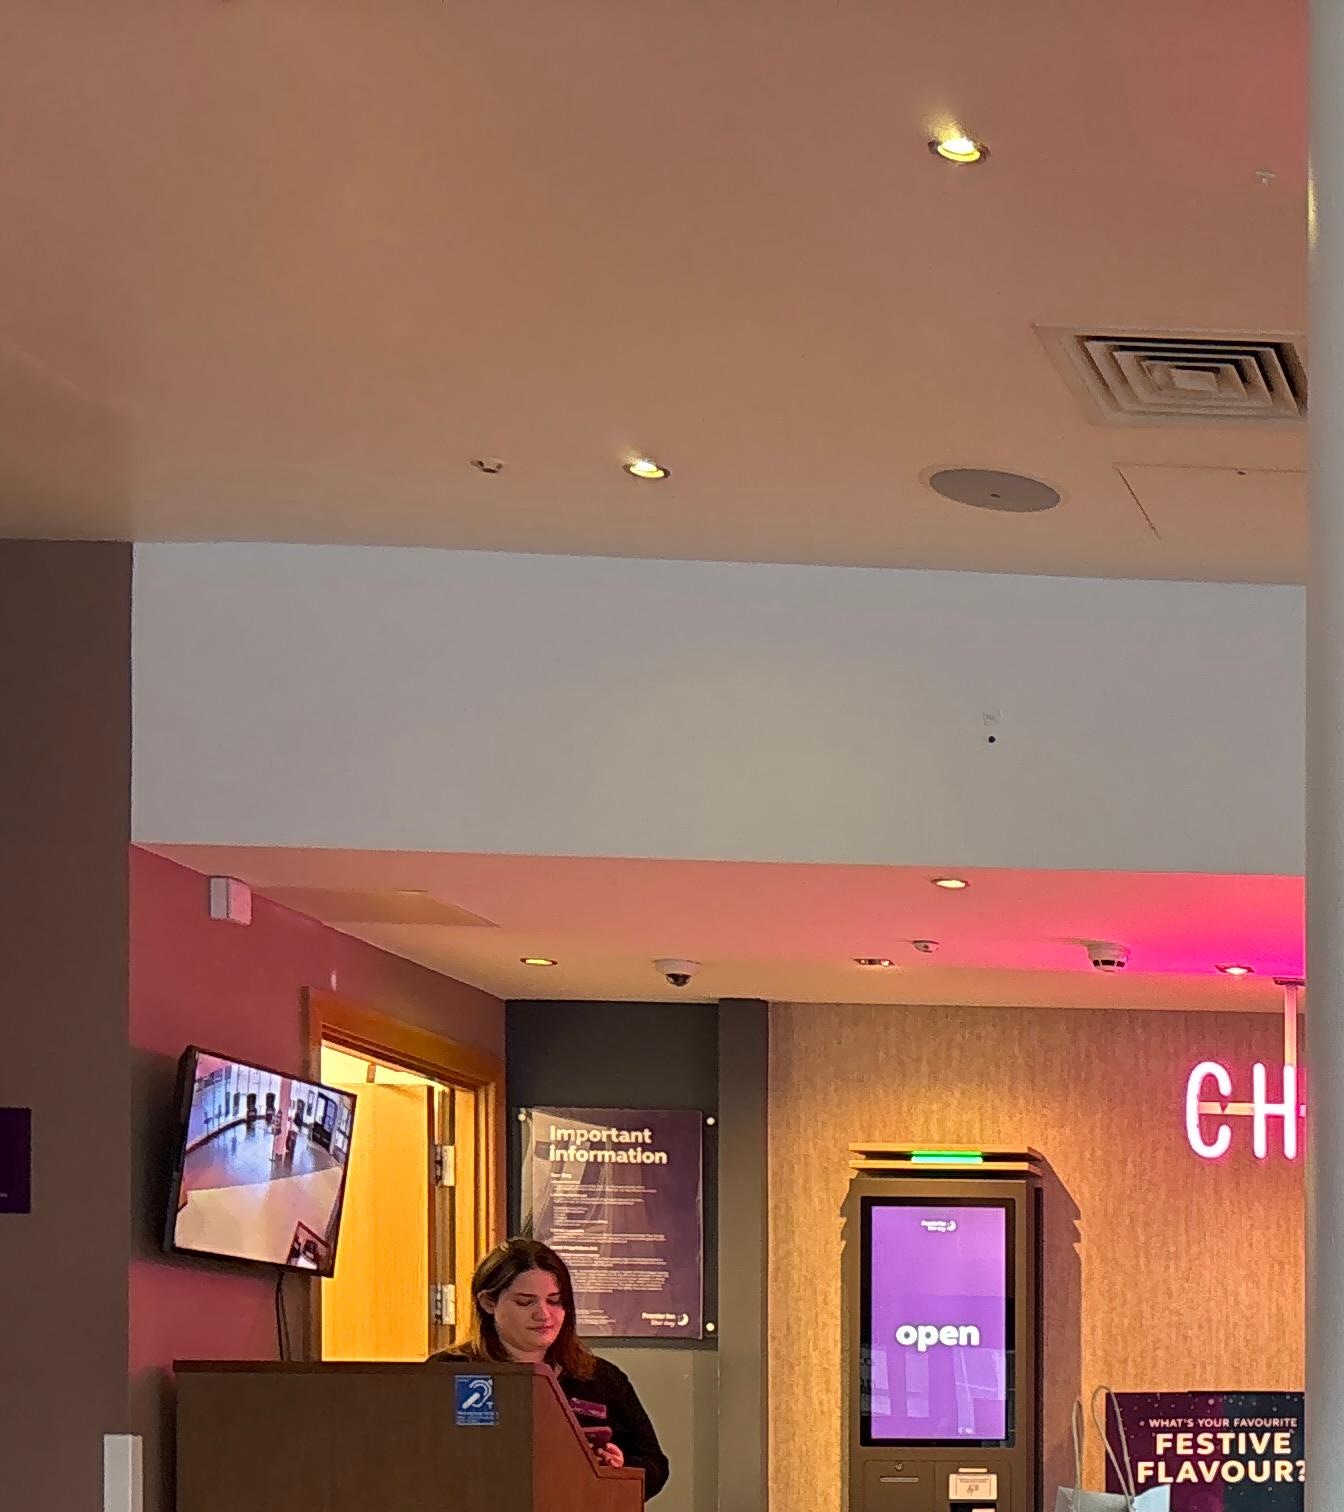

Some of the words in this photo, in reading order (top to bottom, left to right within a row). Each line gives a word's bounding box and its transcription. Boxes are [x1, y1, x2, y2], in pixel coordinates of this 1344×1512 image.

[1186, 1060, 1297, 1160] CH
[549, 1125, 653, 1146] Important
[549, 1144, 668, 1165] information
[895, 1325, 980, 1352] open
[1149, 1417, 1194, 1428] WHAT'S
[1198, 1417, 1230, 1428] YOUR
[1233, 1417, 1298, 1428] FAVOURITE
[1155, 1432, 1292, 1455] FESTIVE
[1137, 1460, 1306, 1484] FLAVOUR?
